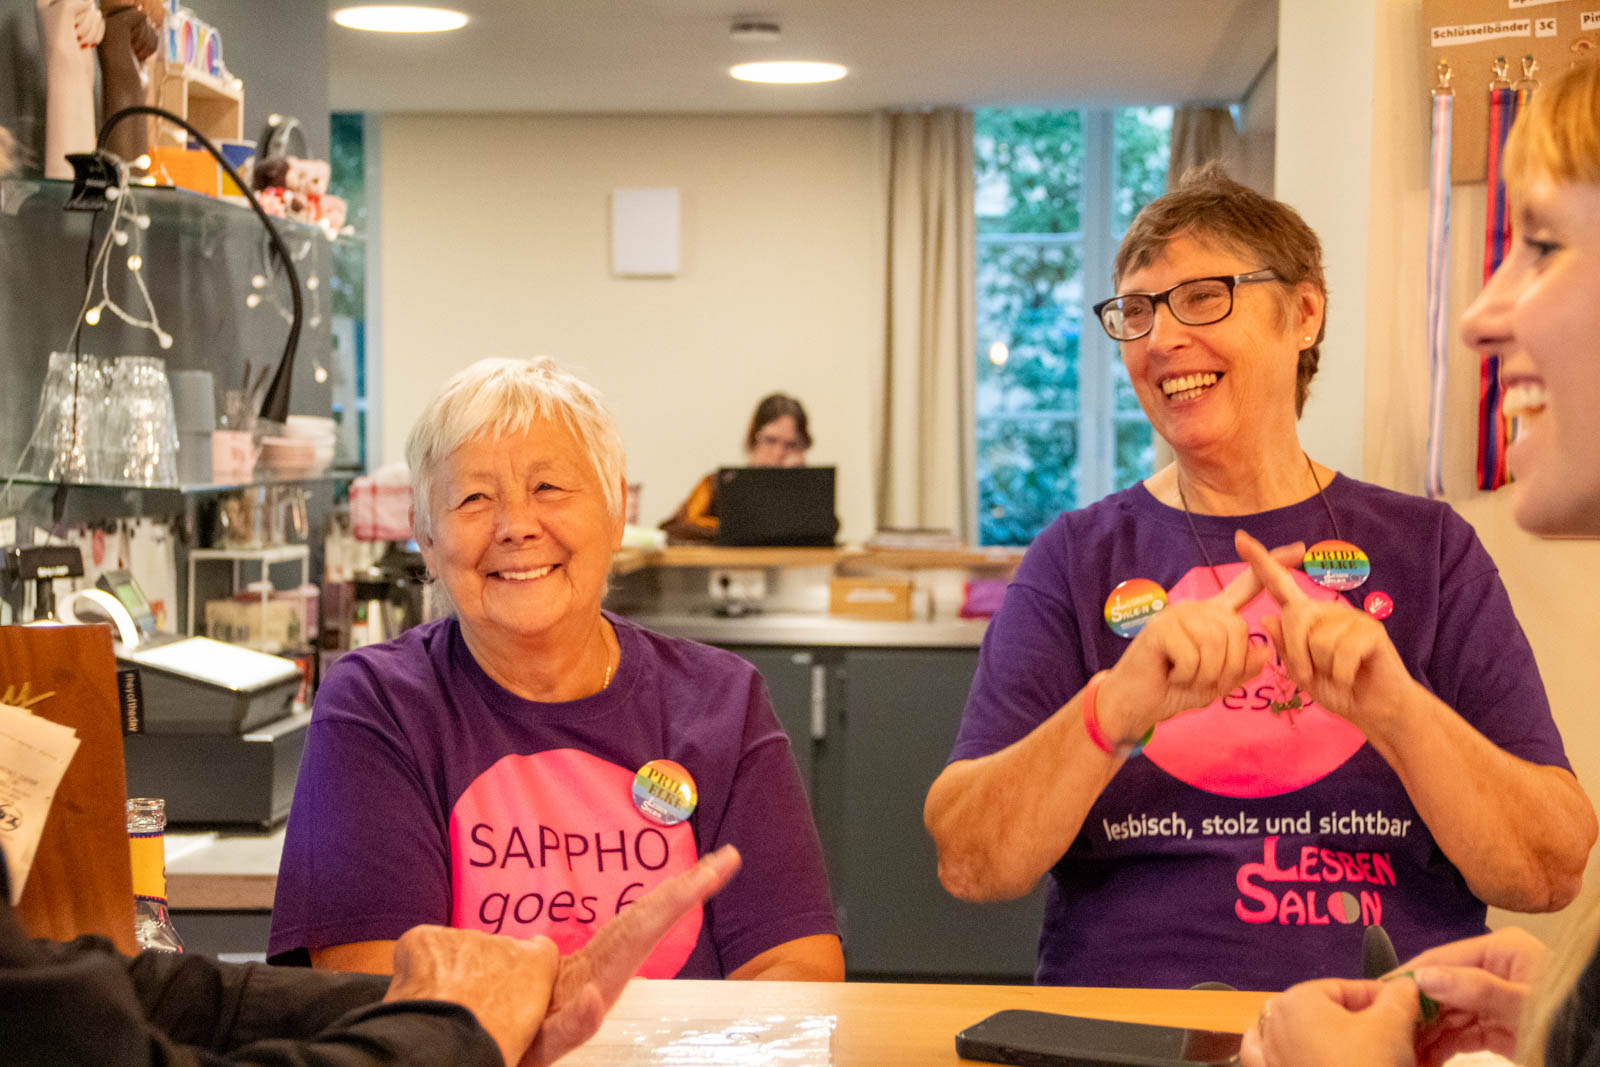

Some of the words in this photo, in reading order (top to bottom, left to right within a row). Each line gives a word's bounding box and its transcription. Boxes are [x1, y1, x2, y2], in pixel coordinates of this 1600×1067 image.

[1433, 22, 1529, 39] Schlüsselbänder
[469, 823, 669, 873] SAPPHO
[1102, 811, 1193, 842] lesbisch,
[1202, 811, 1259, 835] stolz
[1266, 810, 1311, 834] und
[1319, 809, 1412, 838] sichtbar
[1263, 836, 1396, 886] LESBEN
[478, 890, 598, 935] goes
[1234, 862, 1383, 926] SALON
